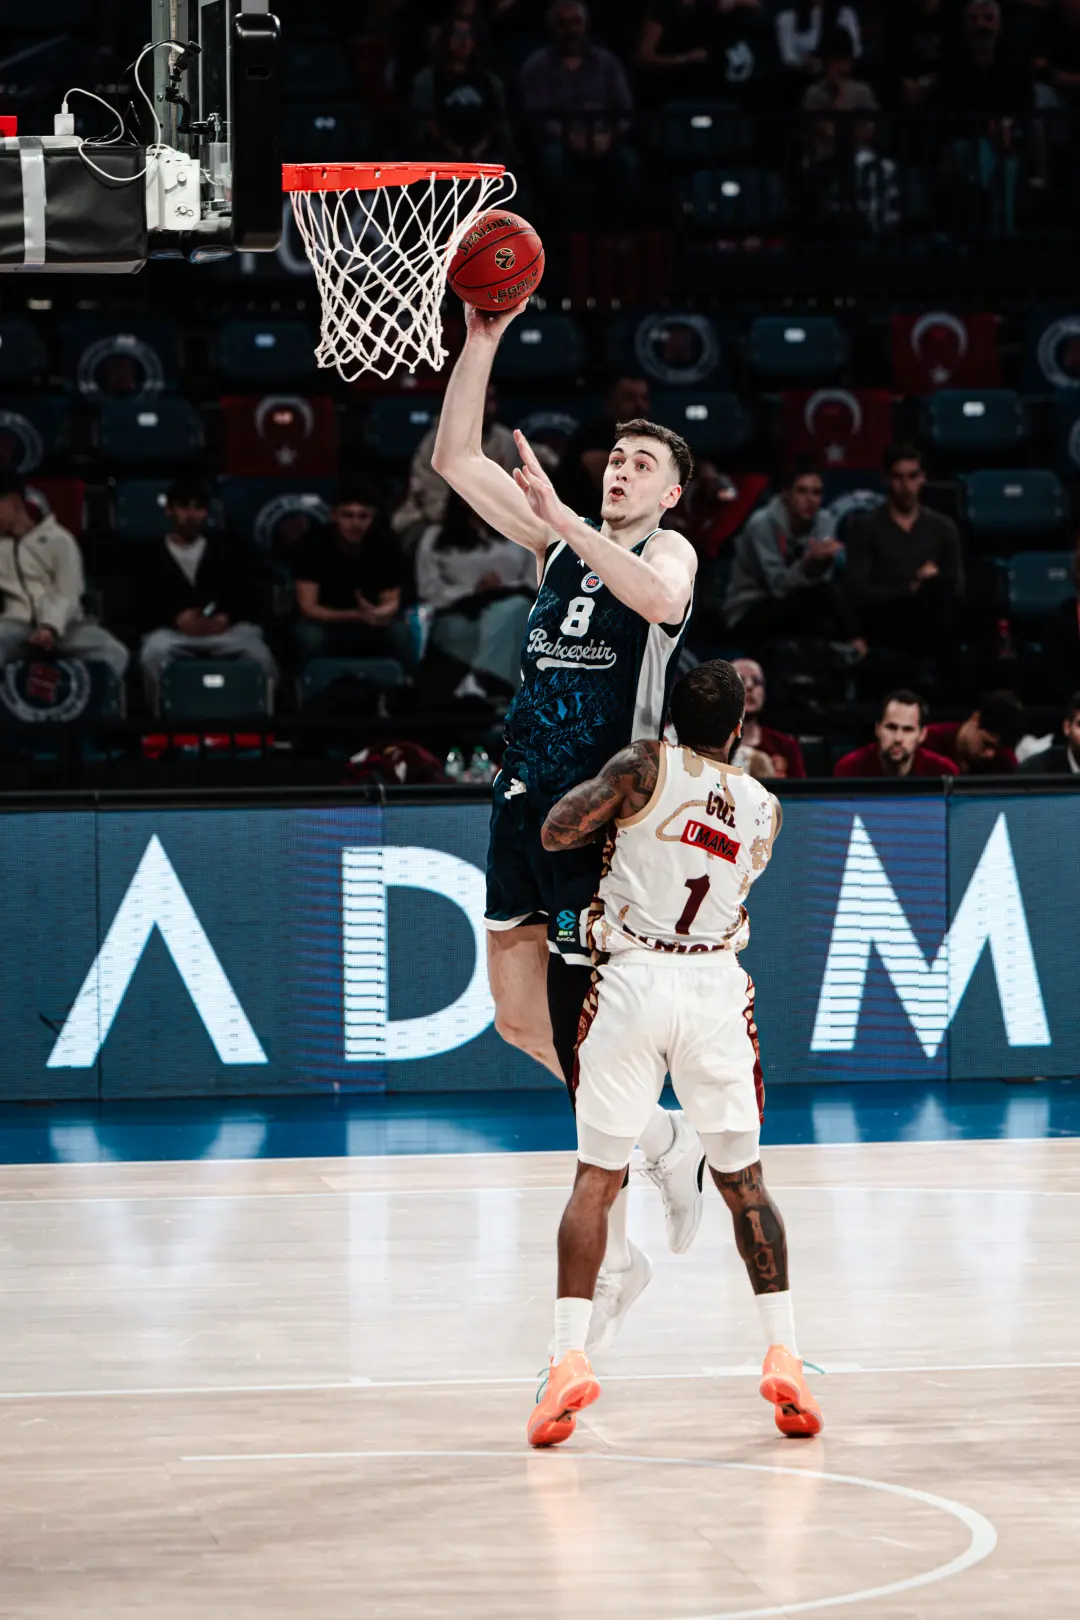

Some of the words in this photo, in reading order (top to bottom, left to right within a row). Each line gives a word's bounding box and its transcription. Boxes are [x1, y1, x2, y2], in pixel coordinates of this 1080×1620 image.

[458, 216, 521, 256] SPALDING
[487, 267, 538, 299] LEGACY
[560, 596, 595, 637] 8
[675, 874, 710, 935] 1
